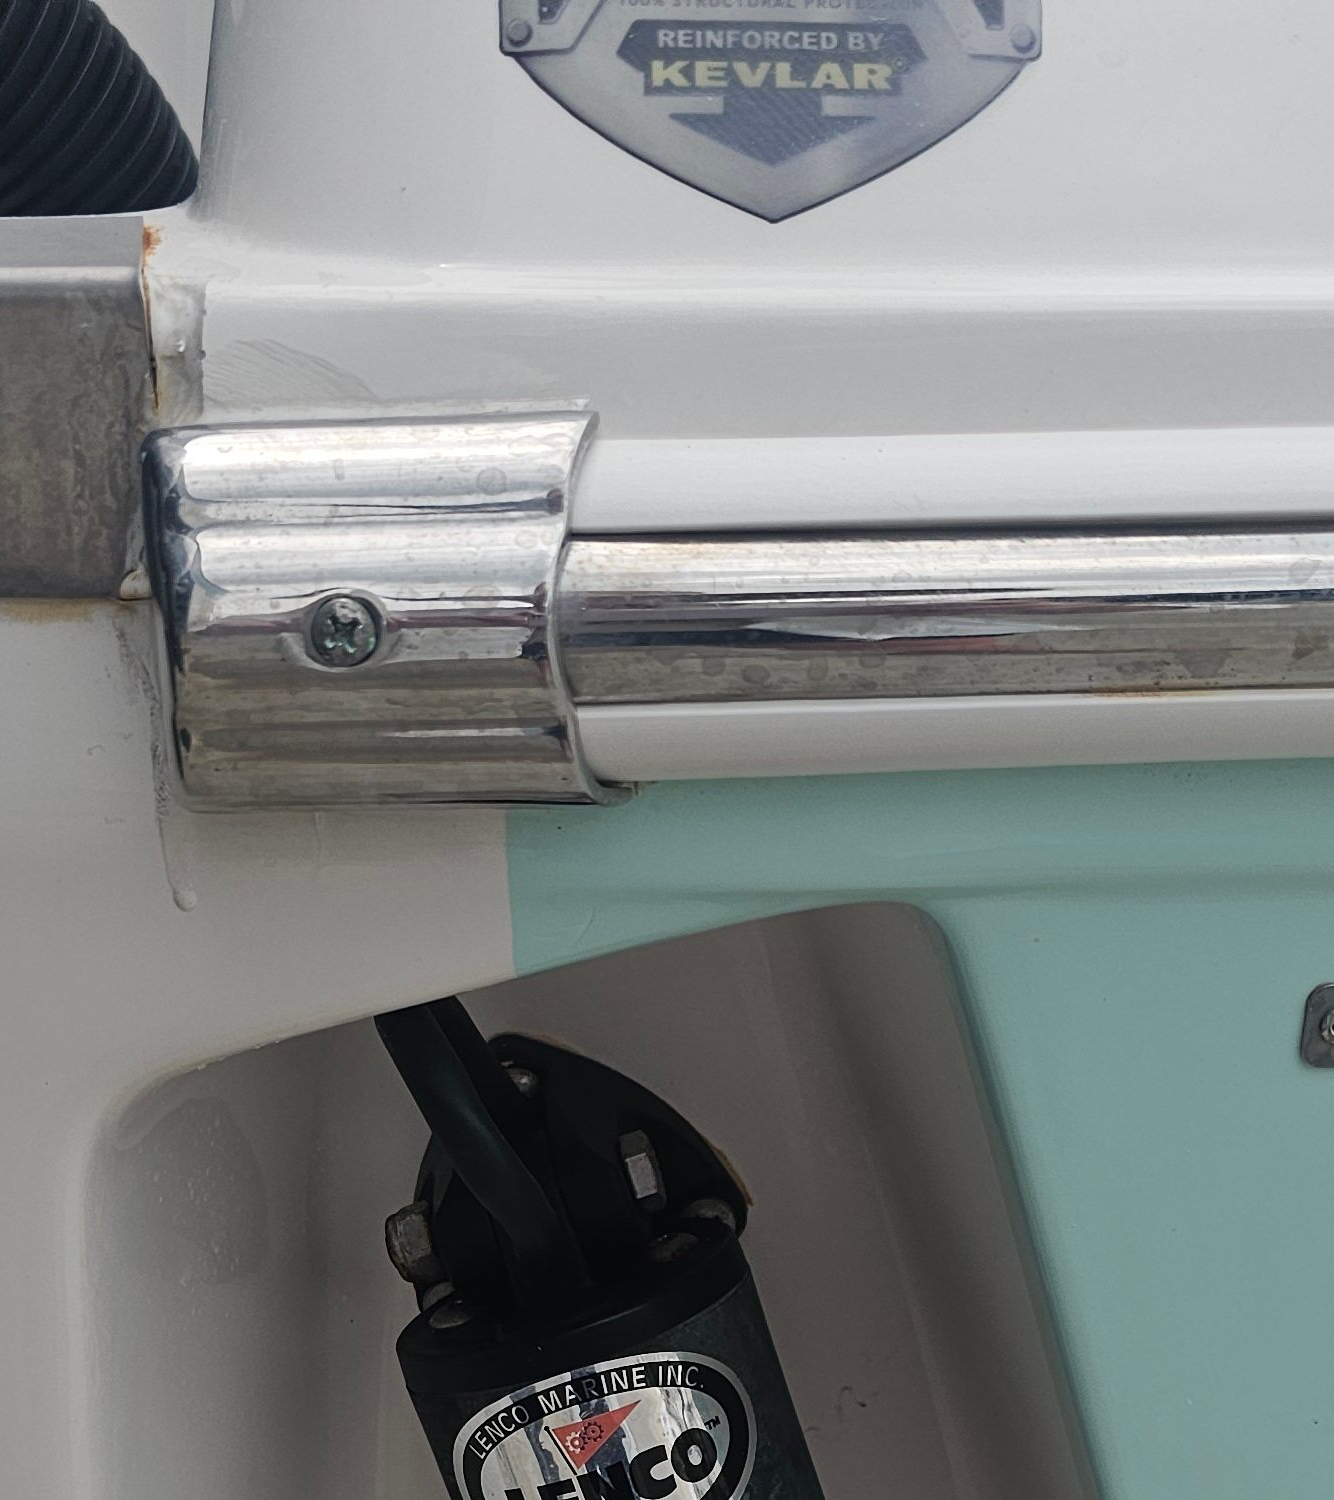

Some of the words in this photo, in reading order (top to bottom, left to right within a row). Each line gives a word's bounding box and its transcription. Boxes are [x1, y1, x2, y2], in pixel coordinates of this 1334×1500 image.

[657, 29, 838, 51] REINFORCED
[847, 31, 885, 51] BY
[468, 1405, 530, 1460] LENCO
[537, 1365, 648, 1415] MARINE
[657, 1363, 705, 1389] INC.
